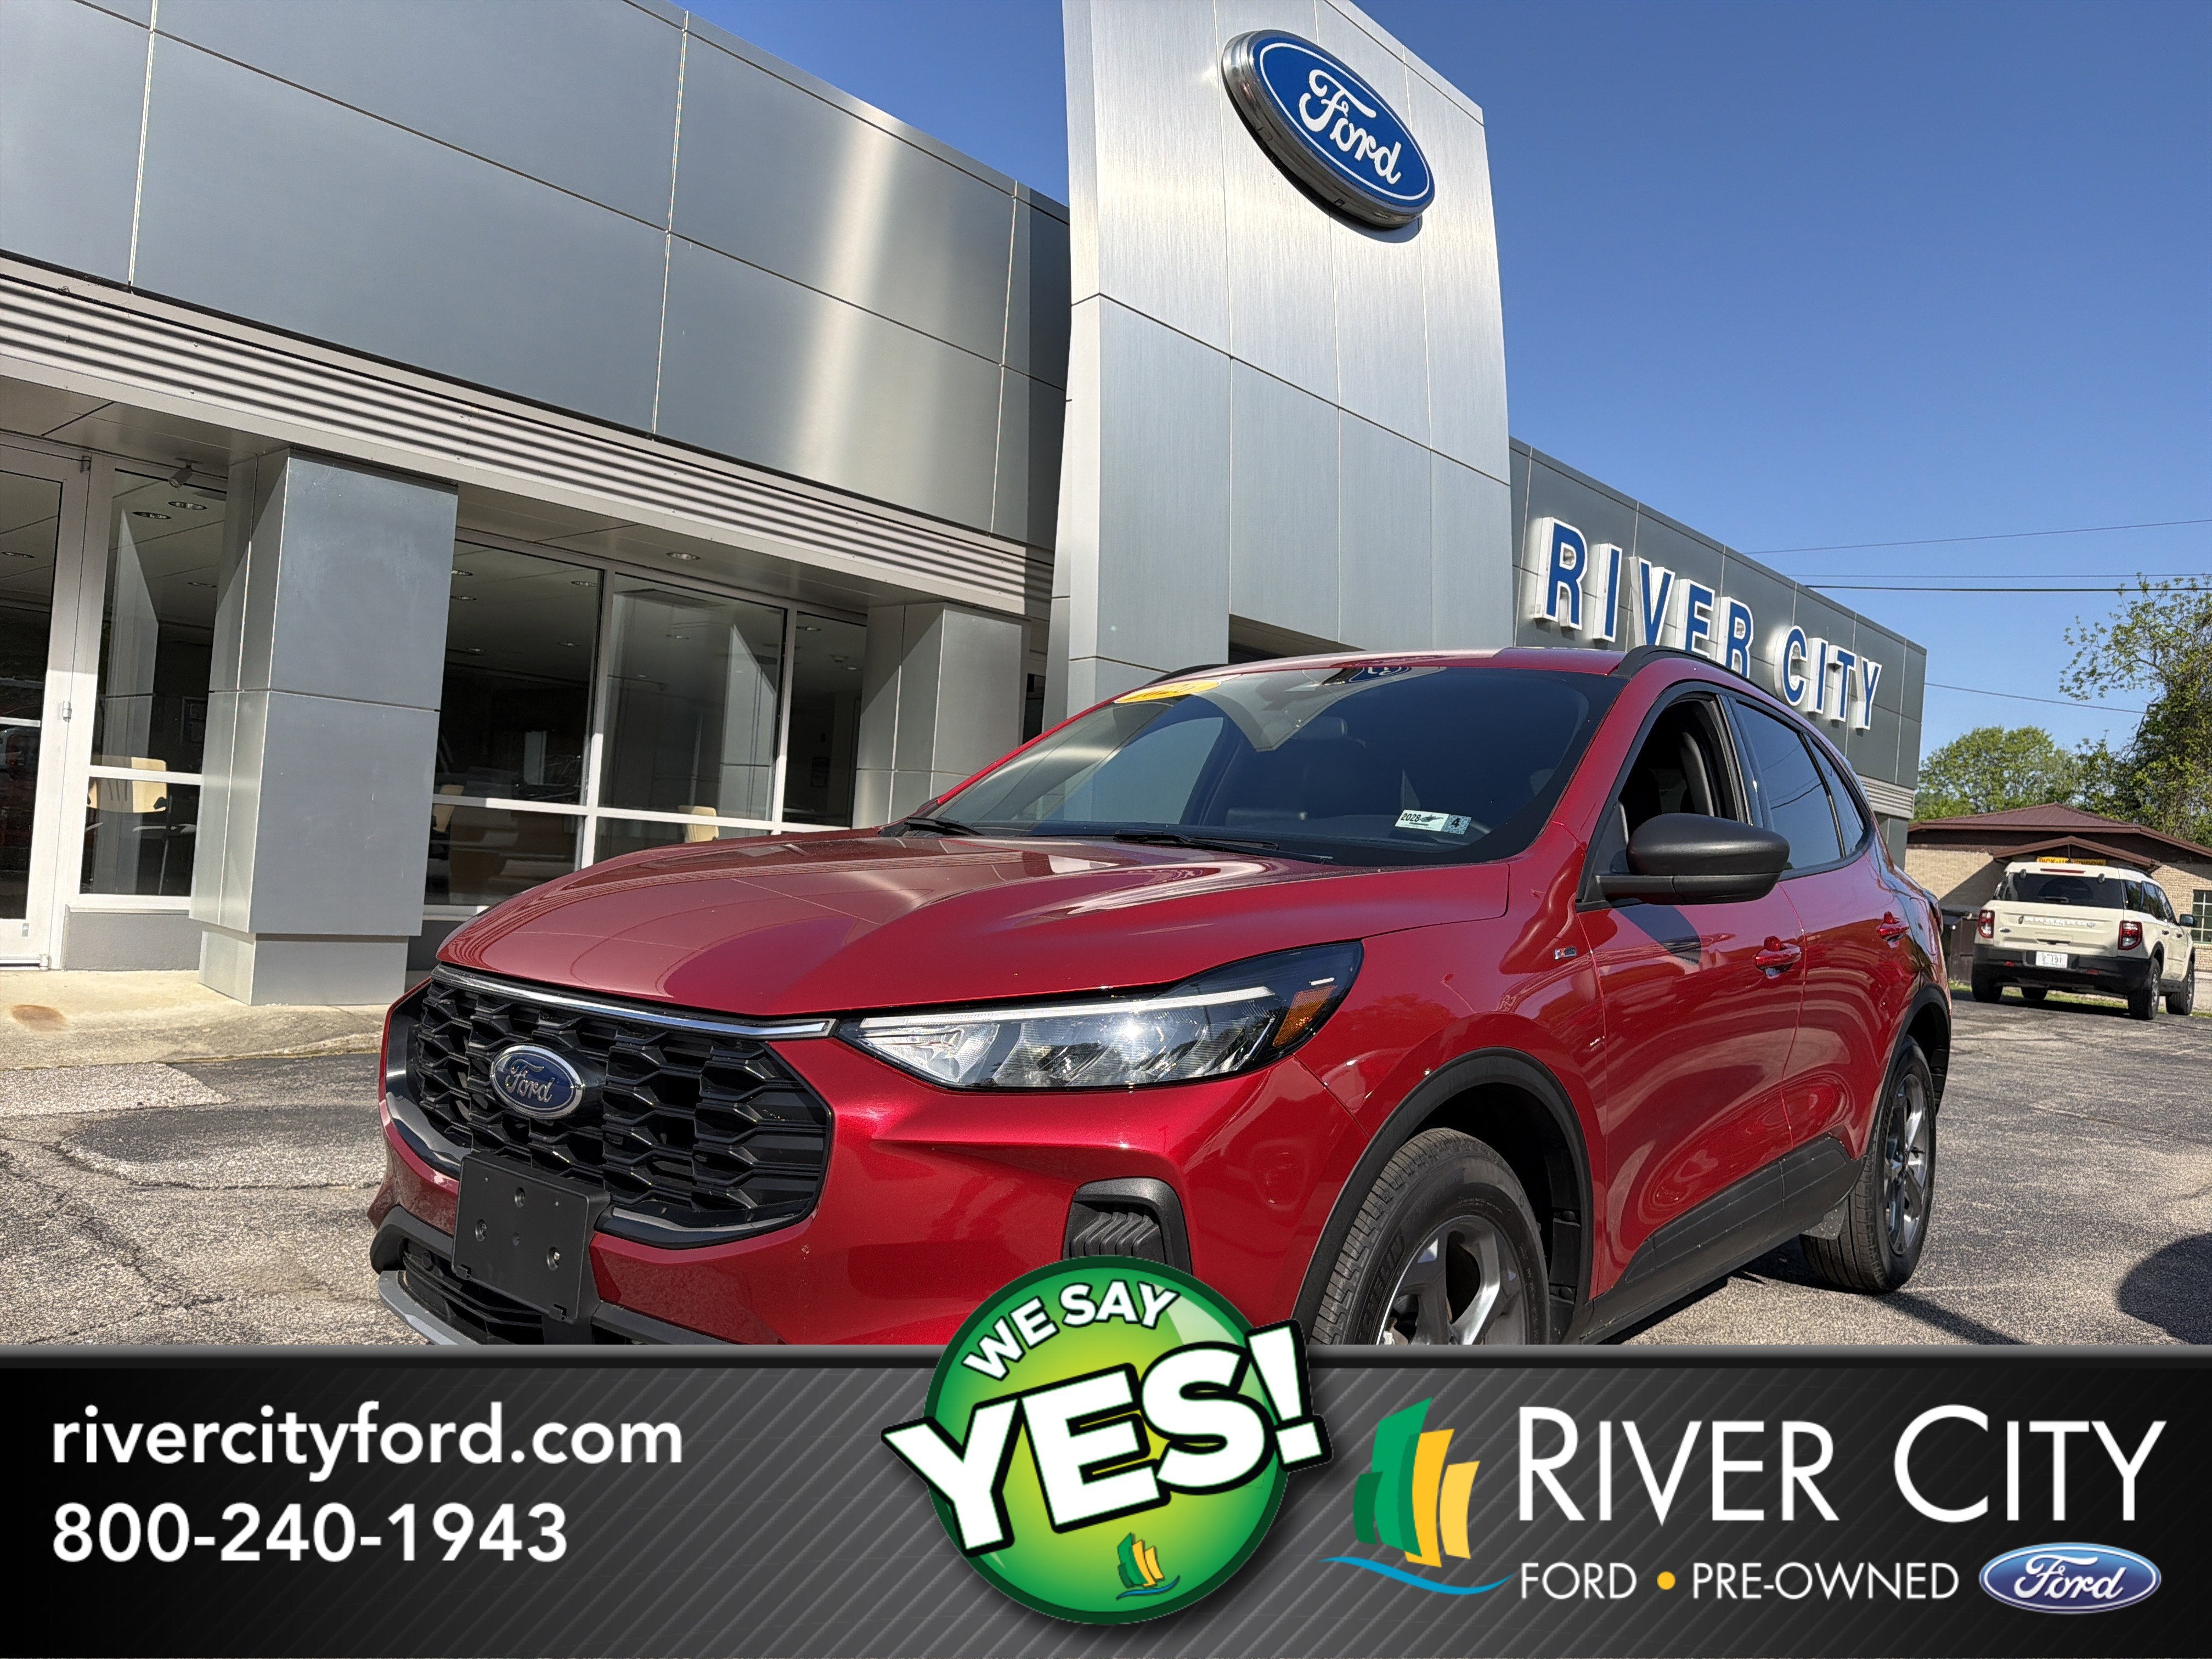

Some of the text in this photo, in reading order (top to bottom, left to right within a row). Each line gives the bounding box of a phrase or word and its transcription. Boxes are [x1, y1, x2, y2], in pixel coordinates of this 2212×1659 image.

[1299, 69, 1402, 185] Ford
[1533, 517, 1882, 731] RIVER CITY
[1400, 812, 1461, 828] 2028 4
[505, 1058, 556, 1103] Ford
